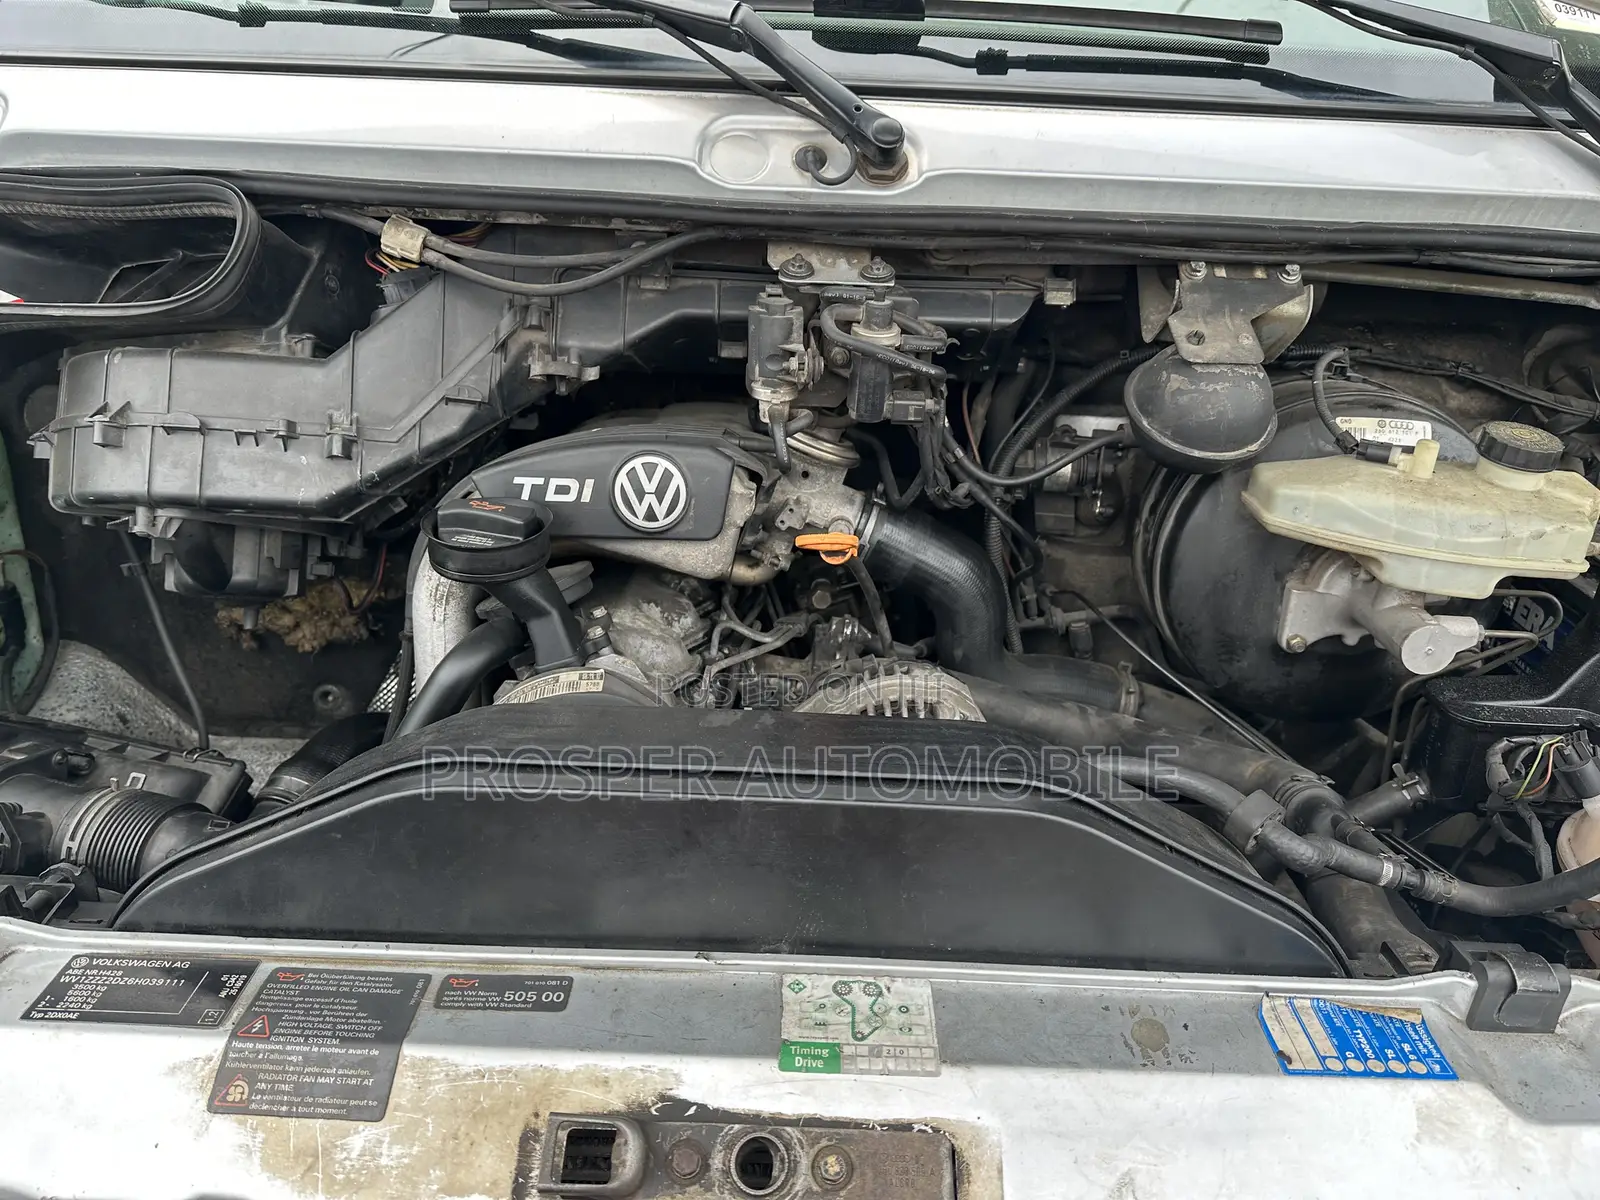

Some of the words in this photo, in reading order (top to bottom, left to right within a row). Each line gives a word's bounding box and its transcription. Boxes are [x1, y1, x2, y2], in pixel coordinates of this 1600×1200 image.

[513, 476, 595, 503] TDI
[92, 958, 172, 968] VOLKSWAGEN
[171, 961, 191, 969] AG
[65, 968, 85, 976] ABE
[60, 975, 185, 987] WV1ZZZ2DZ6H039111
[266, 982, 310, 990] OVERFILLED
[259, 994, 304, 1002] Remplissage
[503, 990, 537, 1002] 505
[541, 991, 565, 1002] 00
[29, 1011, 45, 1019] Typ
[231, 1040, 254, 1049] Haute
[269, 1035, 305, 1043] IGNITION
[1353, 1029, 1376, 1059] TYP200
[789, 1045, 830, 1058] Timing
[1385, 1048, 1397, 1060] SL
[1401, 1043, 1417, 1060] SL.6
[794, 1056, 824, 1068] Drive
[285, 1064, 304, 1072] kann
[303, 1065, 336, 1074] jederzeit
[257, 1072, 299, 1081] RADIATOR
[299, 1075, 316, 1083] FAN
[316, 1076, 336, 1084] MAY
[336, 1077, 362, 1085] START
[362, 1078, 374, 1086] AT
[254, 1082, 273, 1090] ANY
[251, 1092, 262, 1100] Le
[262, 1093, 302, 1102] ventilateur
[303, 1095, 314, 1103] de
[315, 1096, 348, 1105] radiateur
[349, 1098, 367, 1106] peut
